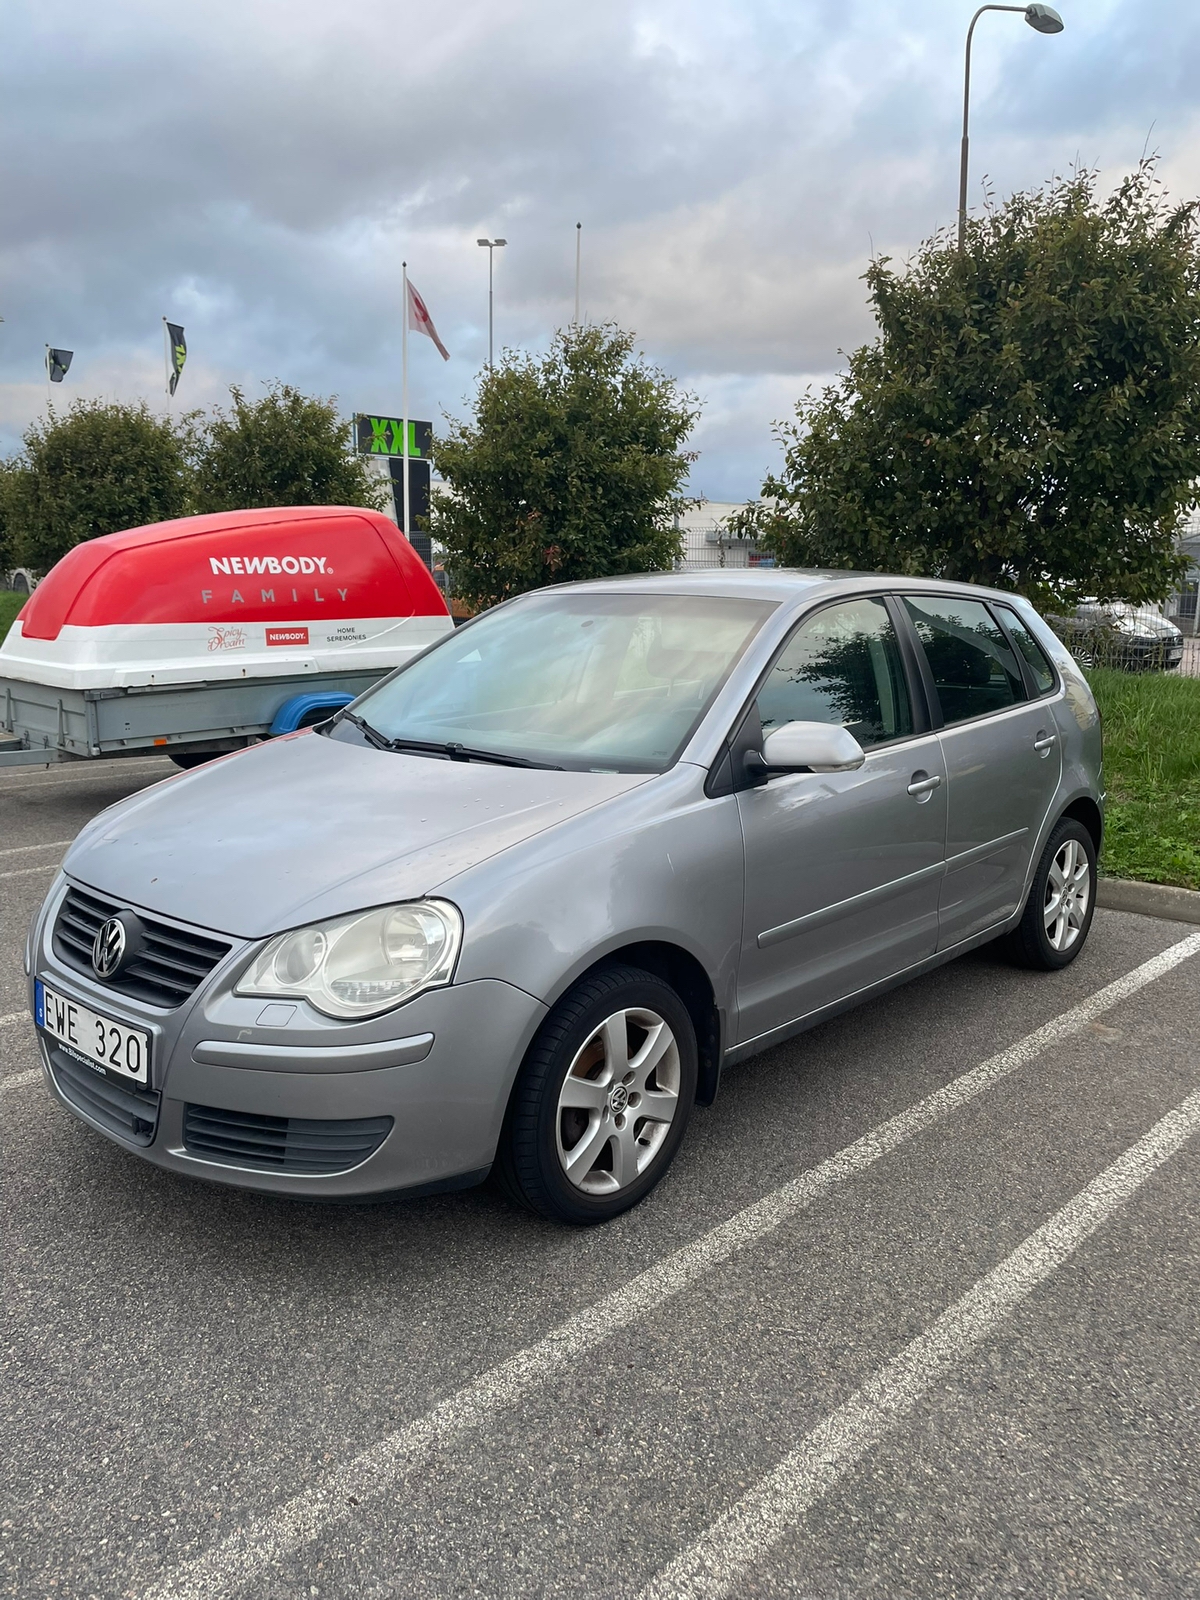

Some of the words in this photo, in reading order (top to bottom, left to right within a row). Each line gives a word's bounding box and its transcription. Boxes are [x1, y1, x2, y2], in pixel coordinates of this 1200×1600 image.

[370, 417, 421, 457] XXL
[201, 588, 348, 604] FAMILY
[208, 626, 247, 643] Spicy
[326, 634, 367, 642] SEREMONIES
[45, 991, 78, 1045] EWE
[95, 1020, 140, 1073] 320
